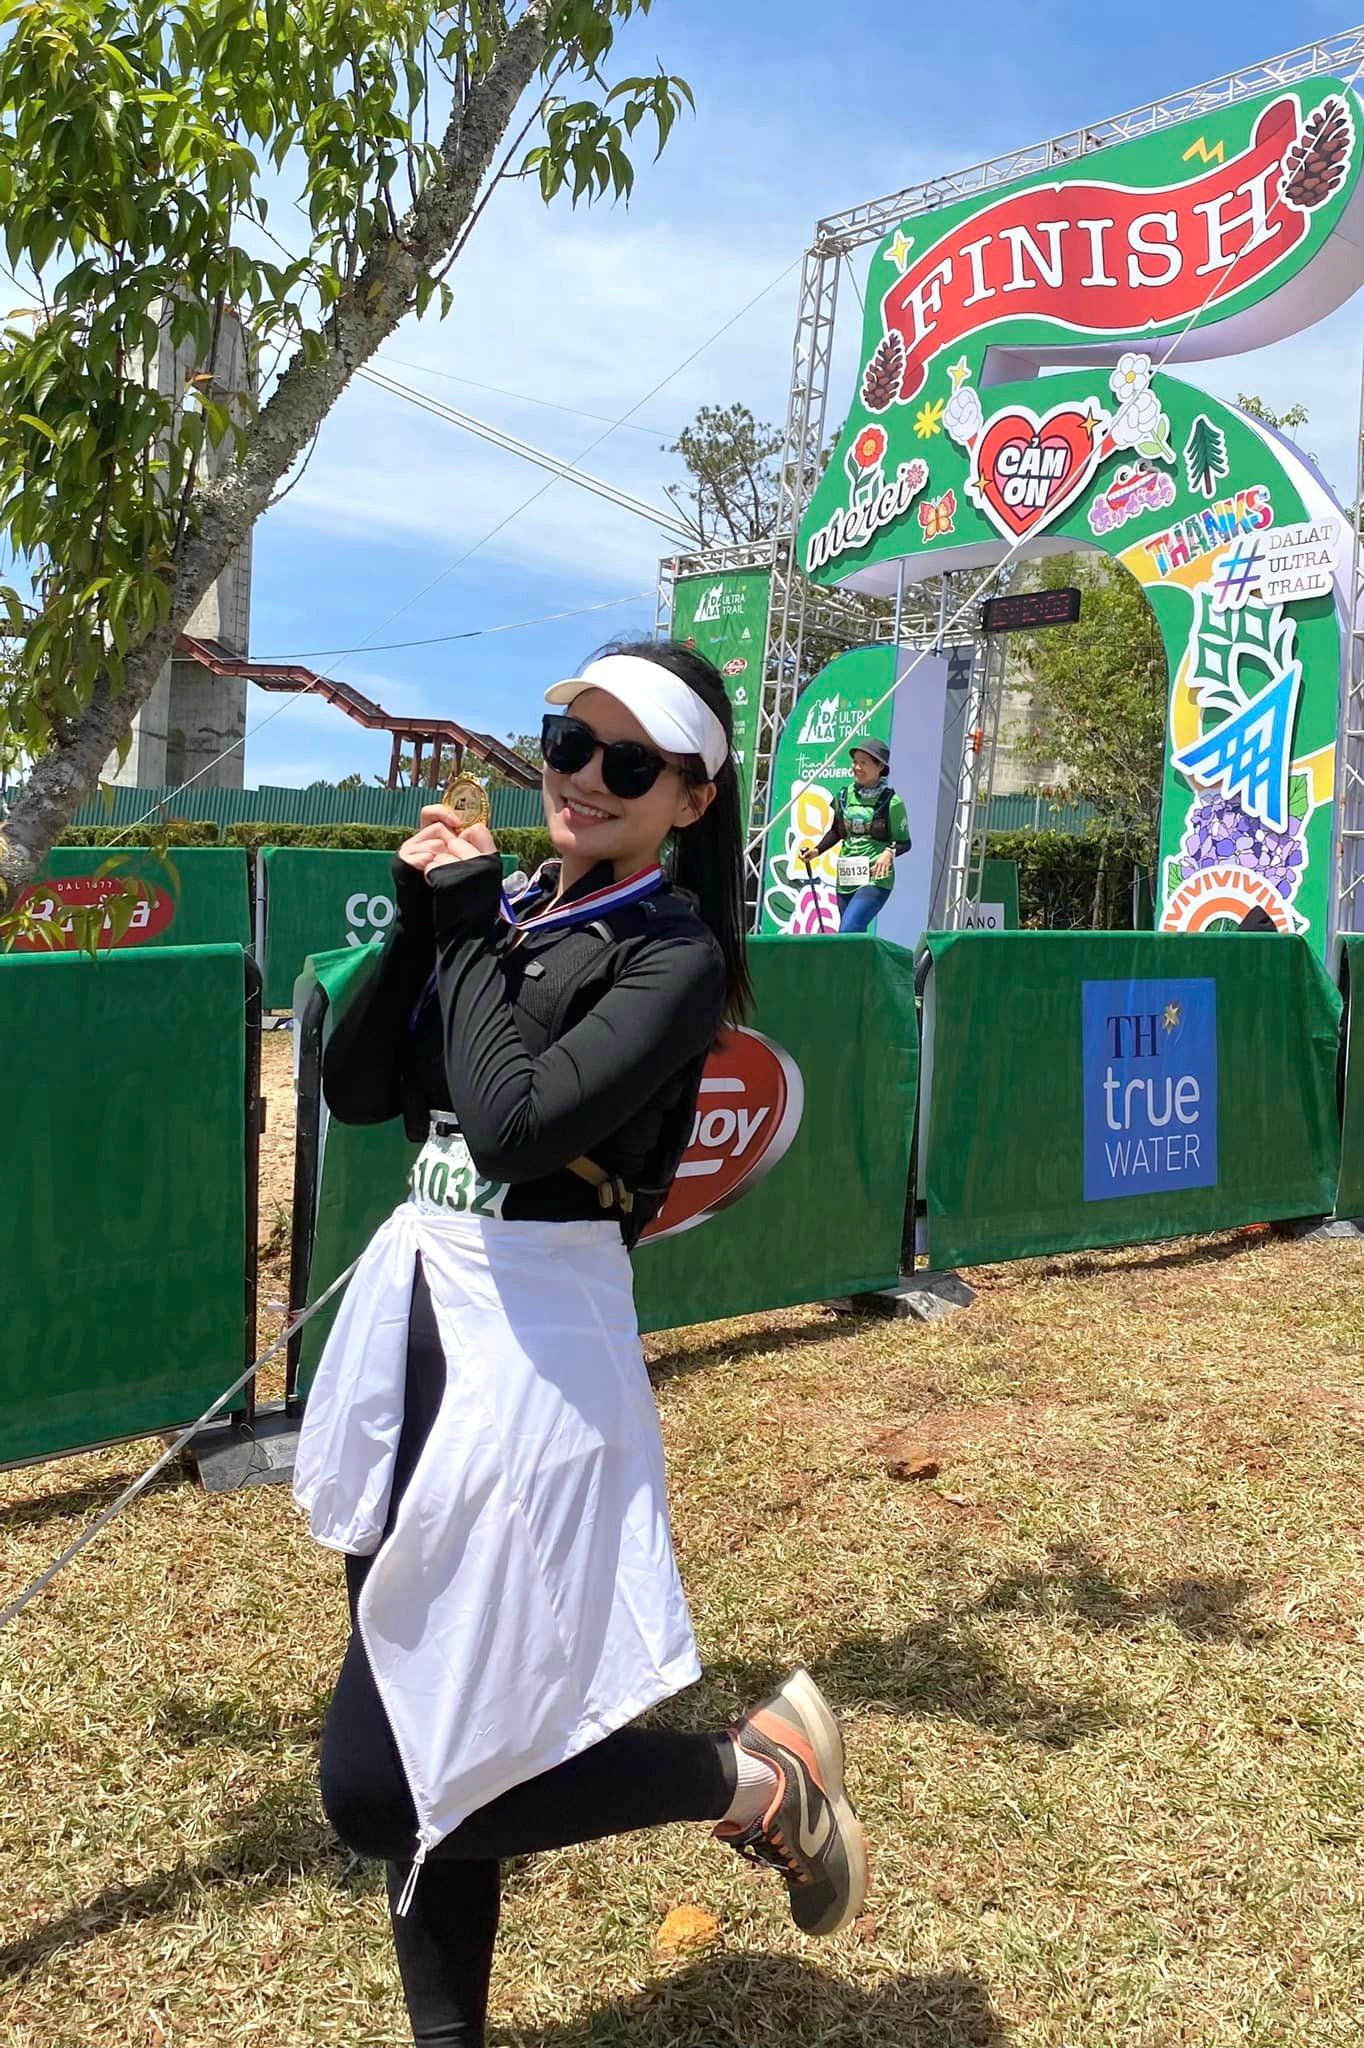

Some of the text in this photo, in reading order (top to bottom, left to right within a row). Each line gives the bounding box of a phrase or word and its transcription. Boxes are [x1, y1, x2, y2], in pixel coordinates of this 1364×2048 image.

[900, 160, 1284, 346] FINISH
[809, 466, 916, 567] merci
[1145, 489, 1273, 578] THANKS
[1269, 525, 1333, 550] DALAT
[1268, 550, 1333, 573] ULTRA
[1267, 574, 1326, 597] TRAIL
[722, 593, 745, 605] ULTRA
[722, 604, 744, 615] TRAIL
[839, 710, 872, 723] ULTRA
[839, 725, 871, 737] TRAIL
[57, 881, 81, 892] DAL
[1106, 1014, 1161, 1059] TH
[1103, 1066, 1200, 1130] true
[1105, 1133, 1201, 1178] WATER
